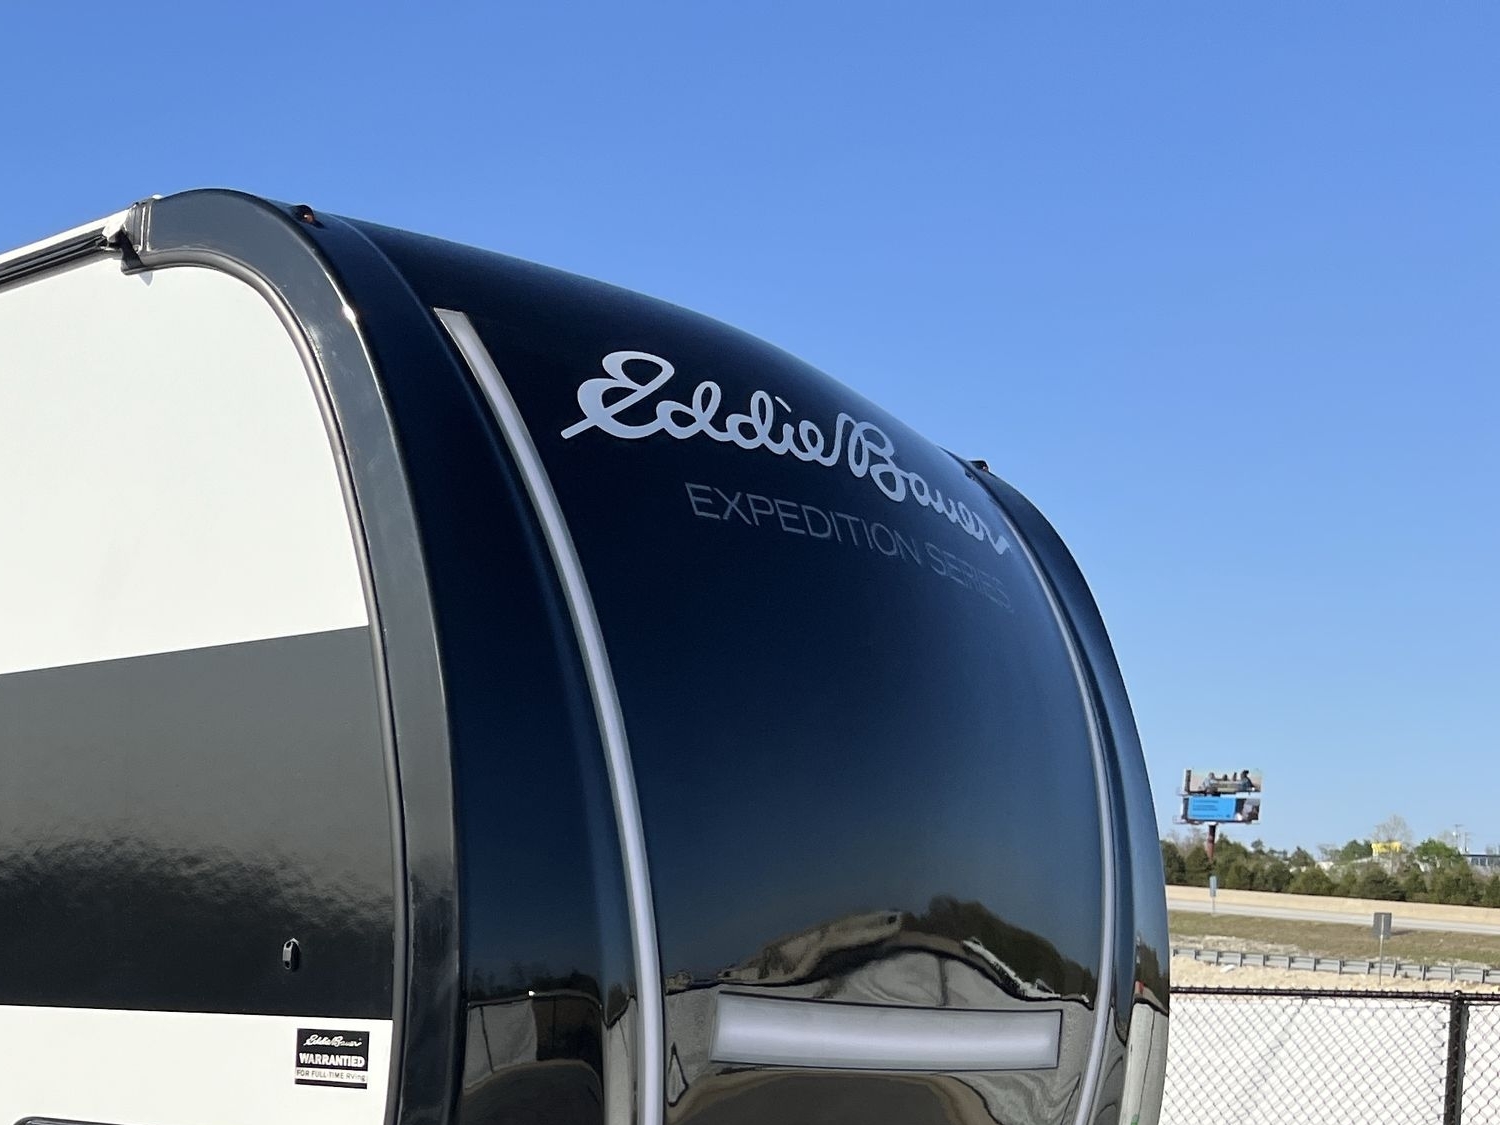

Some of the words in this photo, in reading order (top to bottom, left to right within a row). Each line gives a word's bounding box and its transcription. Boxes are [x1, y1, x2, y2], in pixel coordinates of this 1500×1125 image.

[560, 350, 834, 467] Eddie
[832, 412, 1011, 555] Bauer
[684, 481, 922, 568] EXPEDITION
[924, 541, 1013, 610] SERIES
[296, 1069, 310, 1077] FOR
[299, 1052, 366, 1068] WARRANTIED
